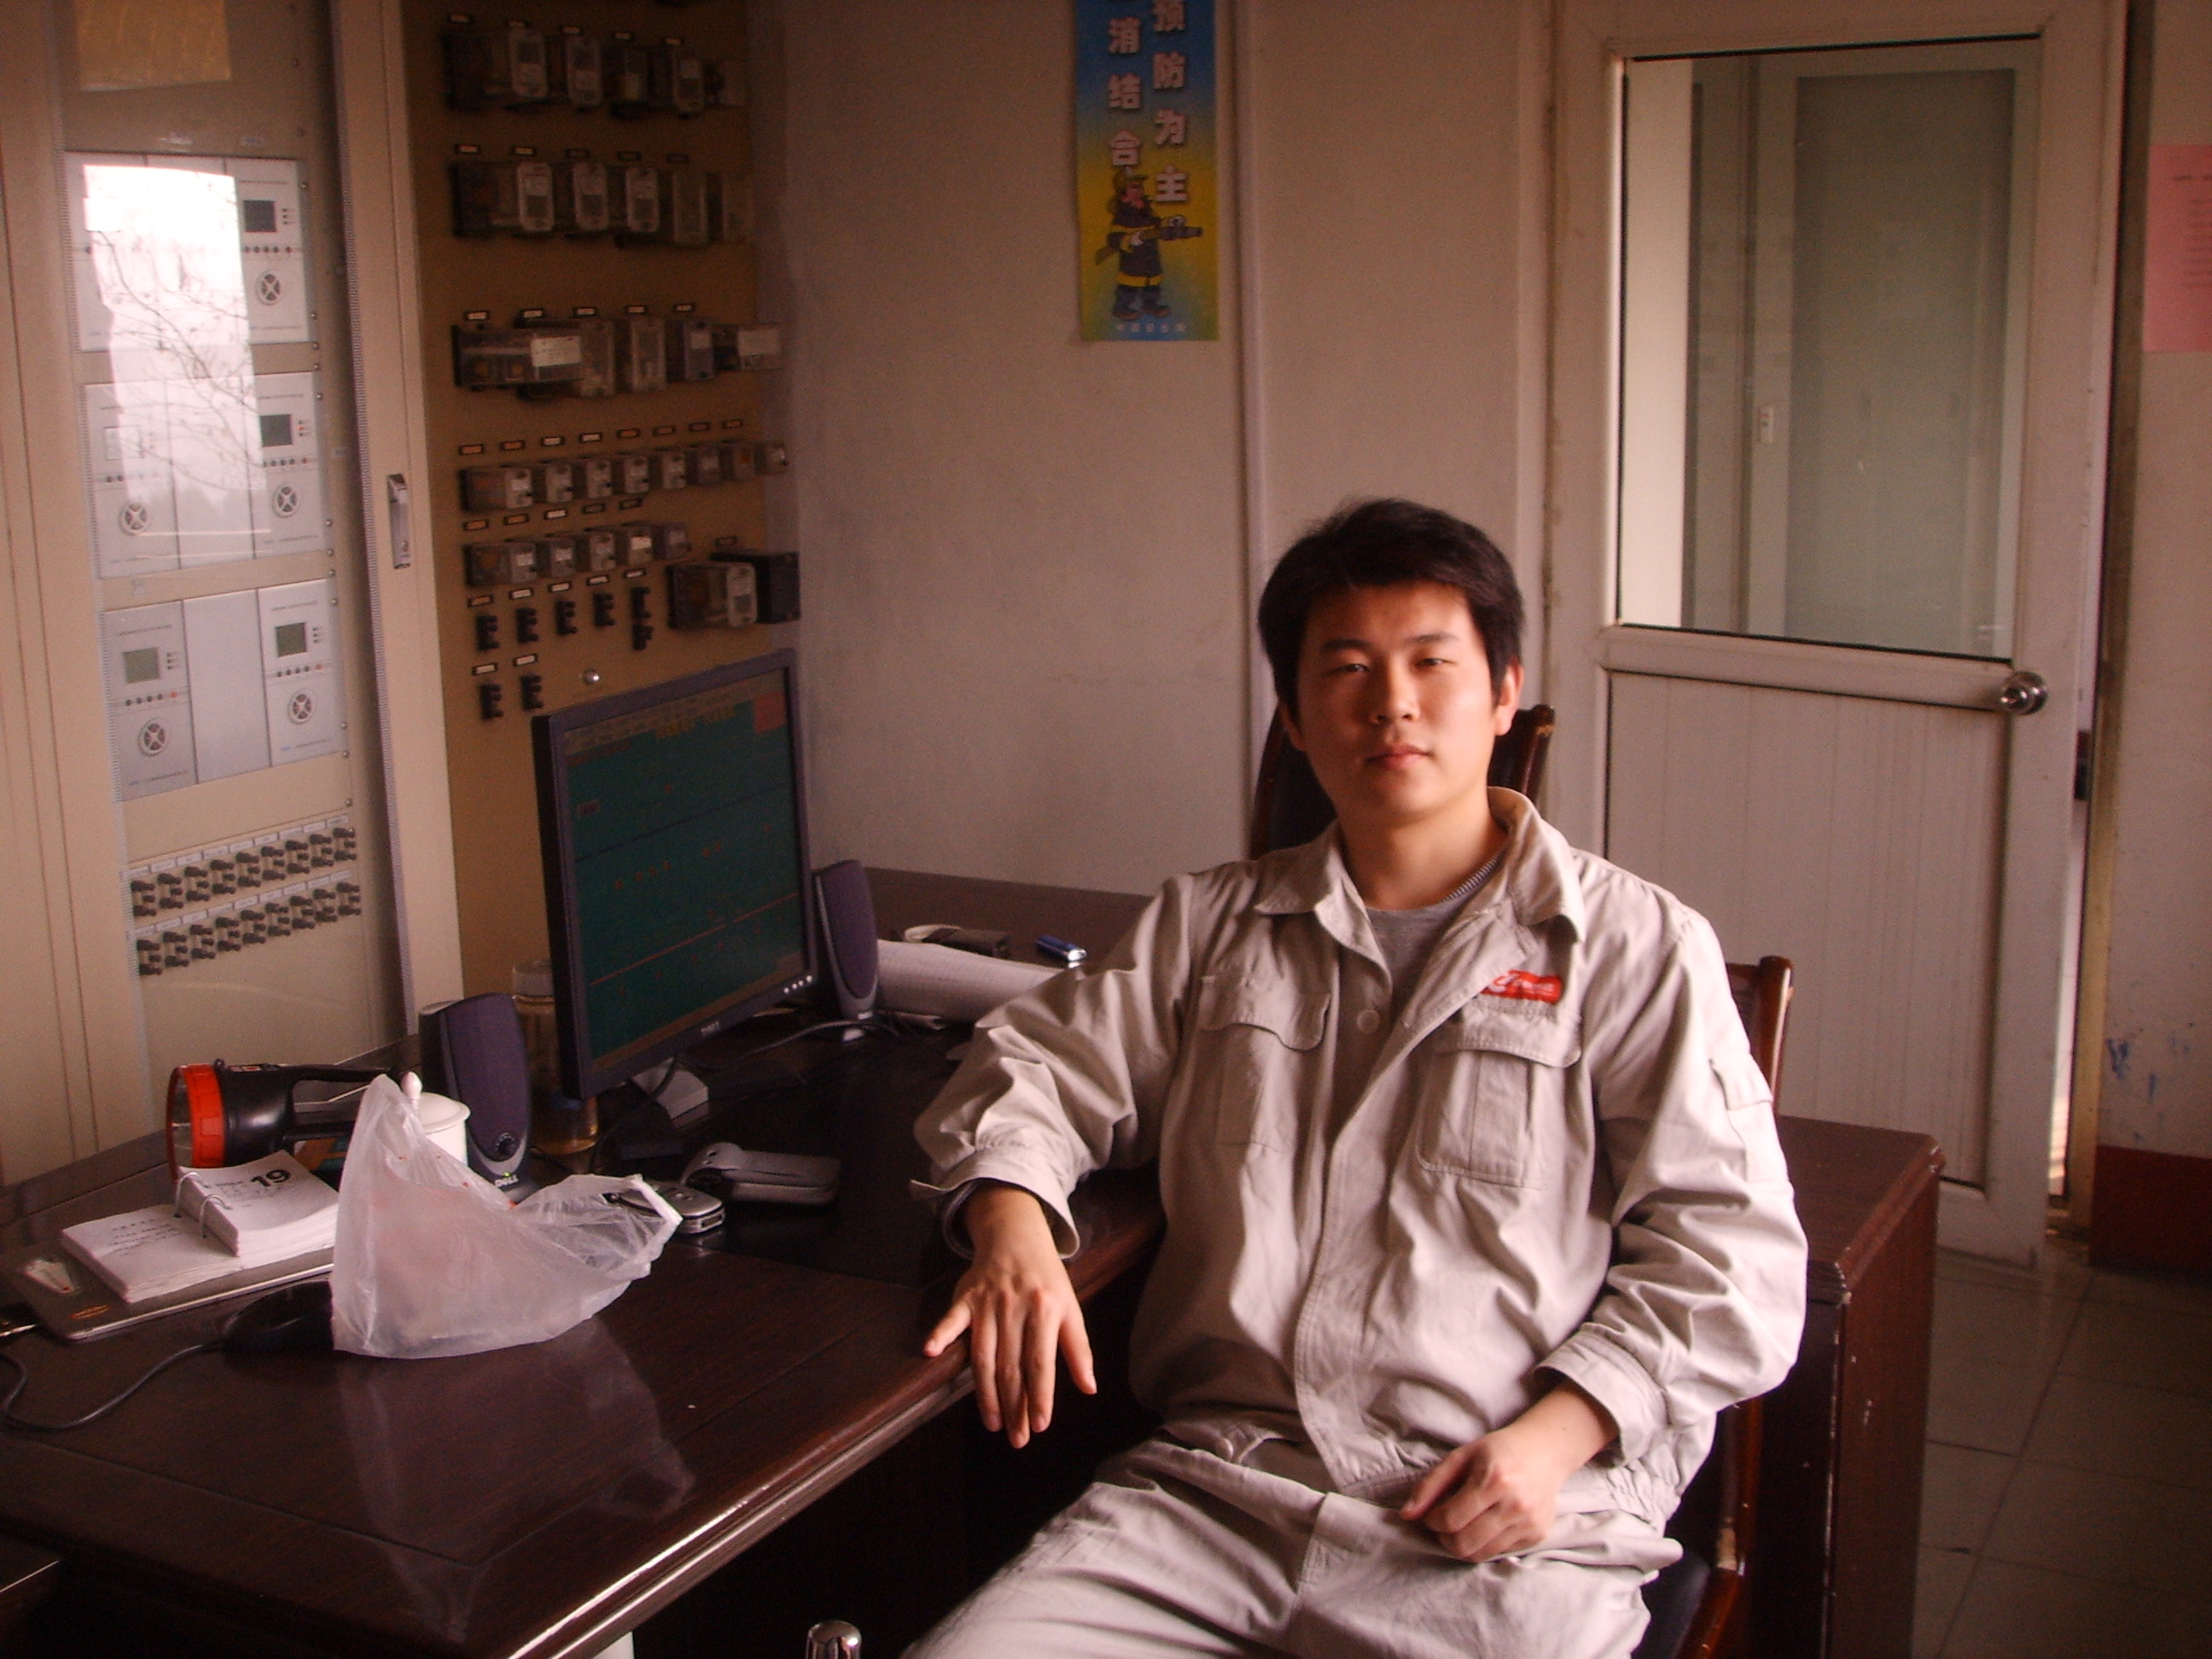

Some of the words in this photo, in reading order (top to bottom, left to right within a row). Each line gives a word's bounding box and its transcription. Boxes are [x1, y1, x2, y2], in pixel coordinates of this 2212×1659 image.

[1152, 0, 1188, 201] 预防为主
[252, 1168, 291, 1187] 19
